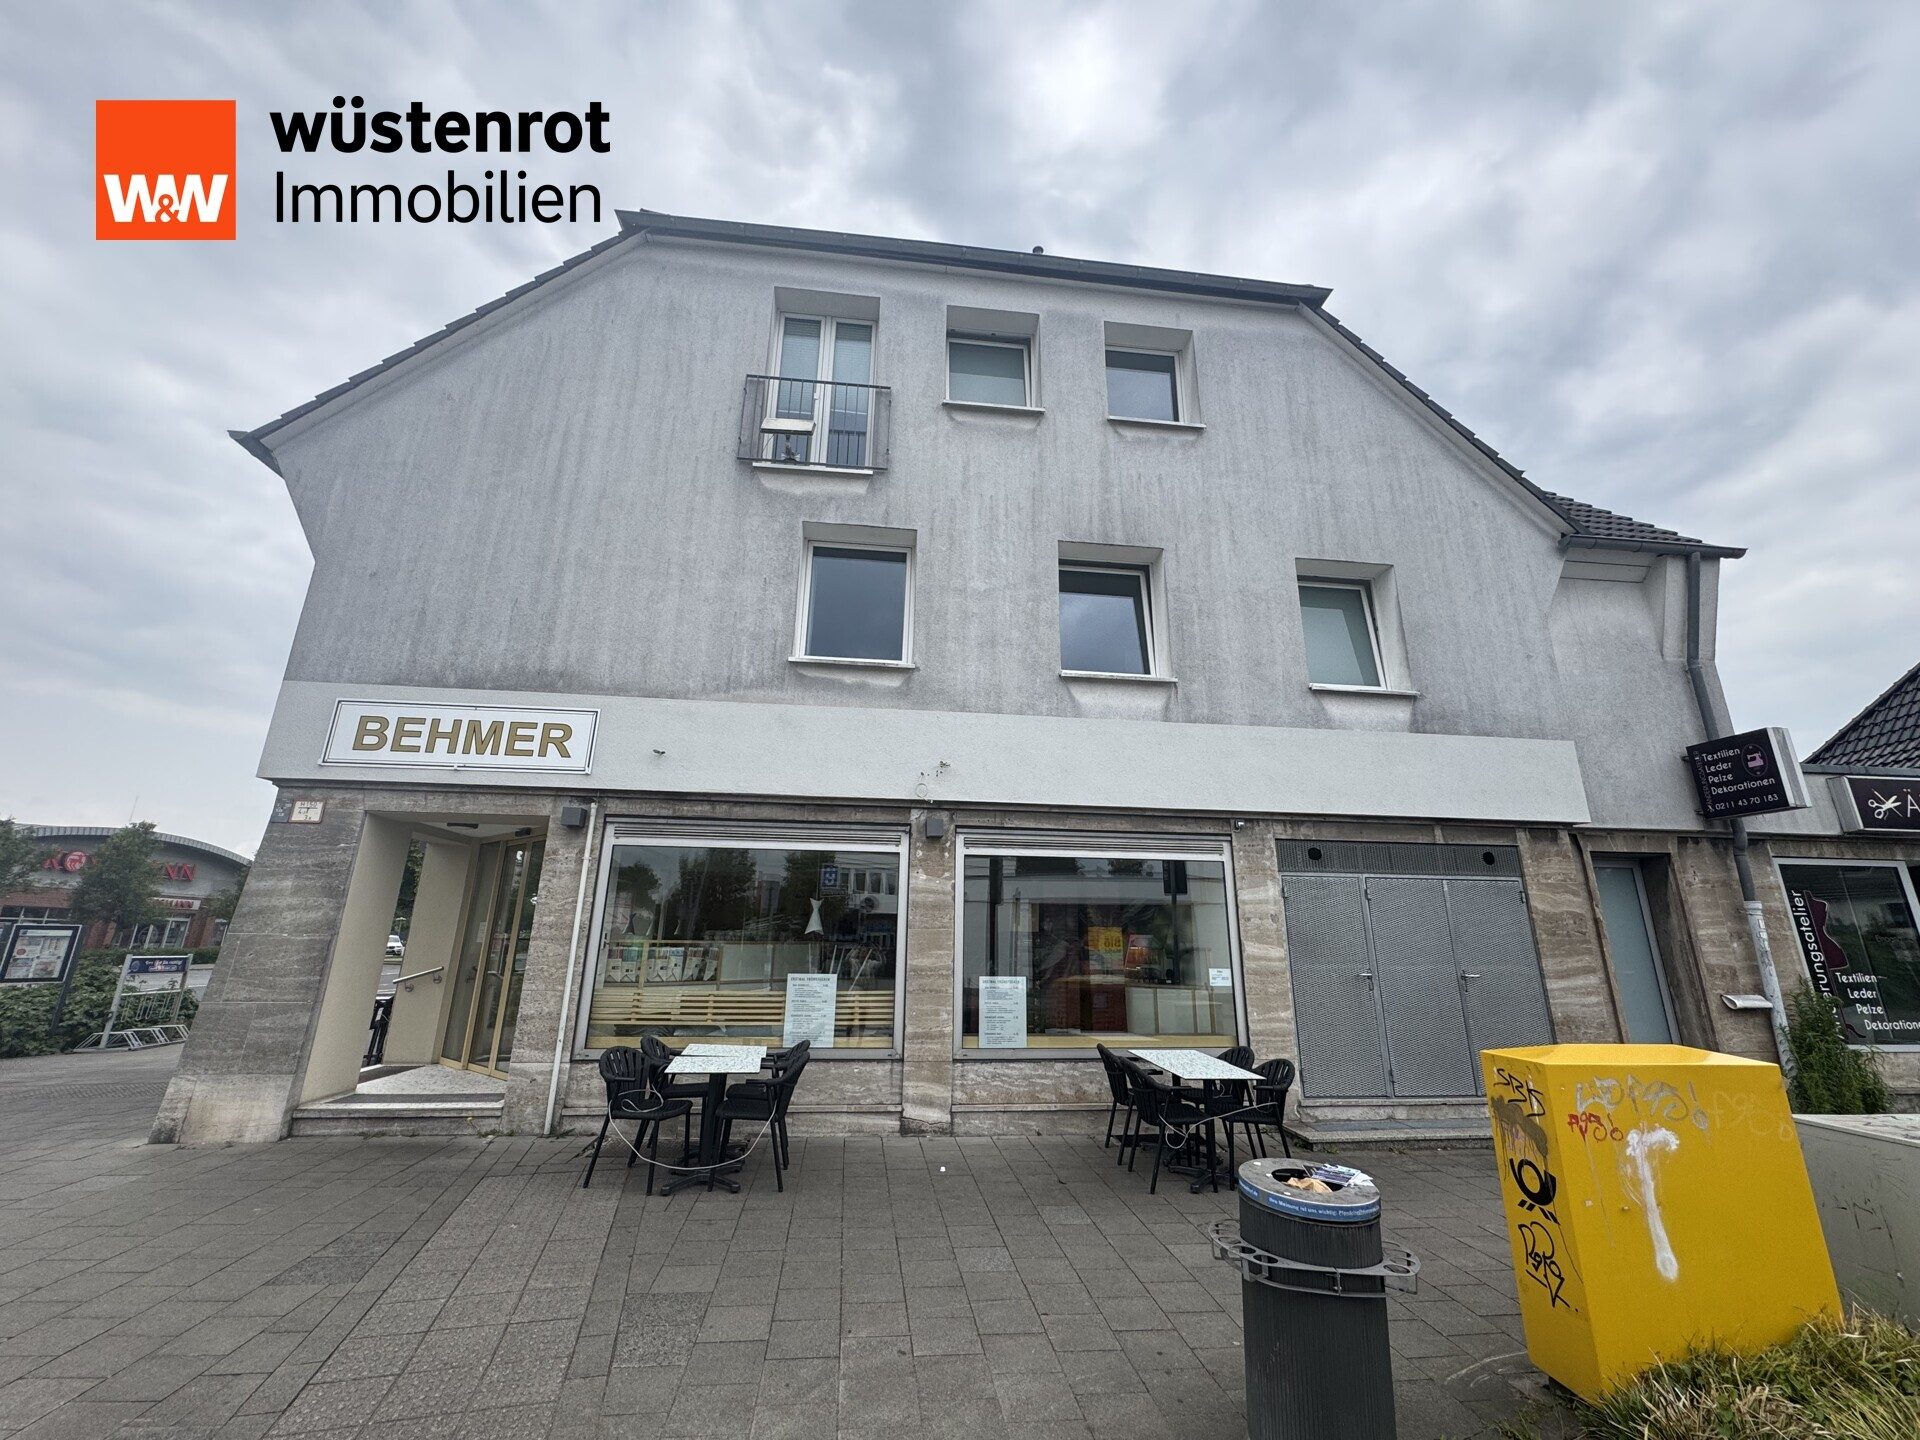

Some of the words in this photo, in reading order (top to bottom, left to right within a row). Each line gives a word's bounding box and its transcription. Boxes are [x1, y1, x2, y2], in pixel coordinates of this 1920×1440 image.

[352, 715, 573, 758] BEHMER
[1702, 748, 1740, 762] Textilien
[1704, 761, 1732, 773] Leder
[1708, 773, 1734, 784] Pelze
[1711, 777, 1776, 795] Dekorationen
[1715, 801, 1735, 810] 0211
[1738, 798, 1748, 806] 43
[1750, 796, 1760, 804] 70
[1763, 793, 1779, 802] 183
[1835, 972, 1878, 983] Textilien
[1847, 988, 1877, 999] Leder
[1855, 1003, 1884, 1014] Pelze
